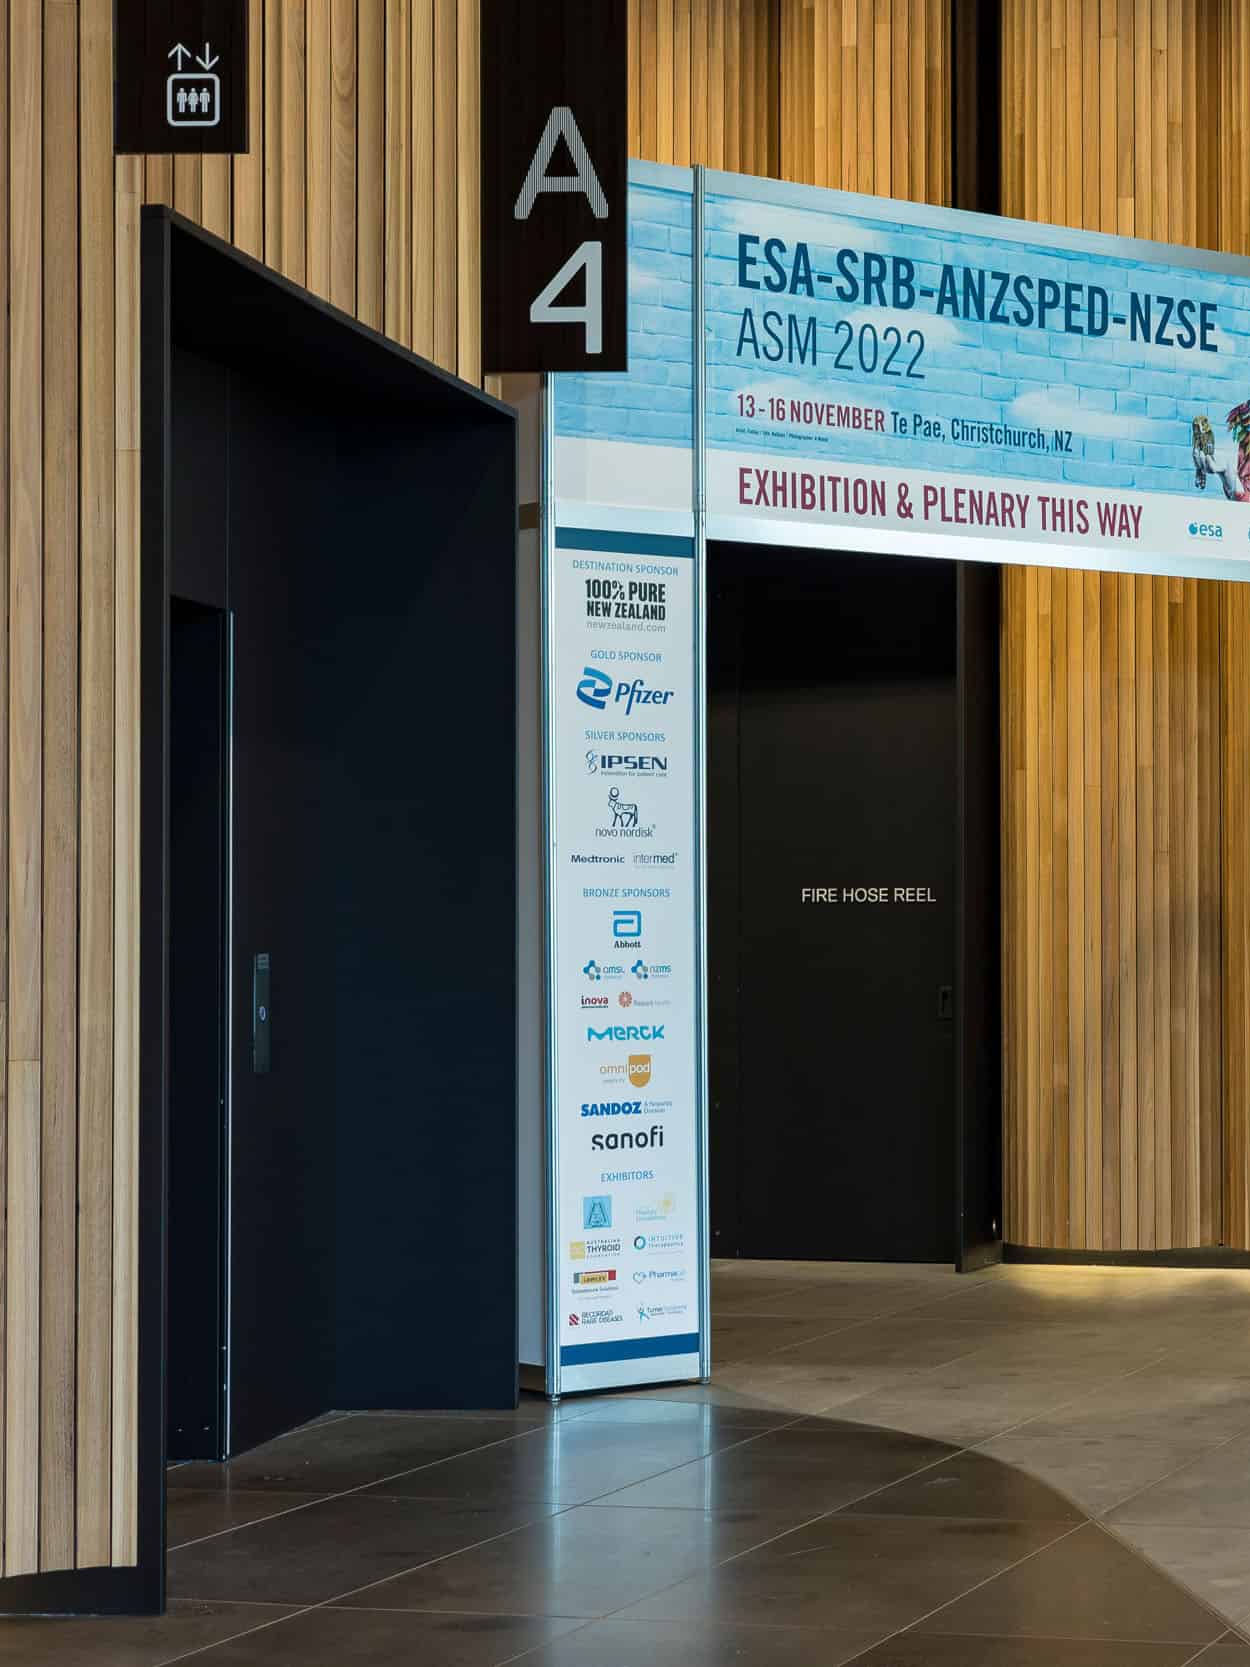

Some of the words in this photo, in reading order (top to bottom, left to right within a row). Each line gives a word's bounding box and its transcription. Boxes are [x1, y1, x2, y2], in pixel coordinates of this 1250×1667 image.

[514, 106, 609, 219] A
[530, 241, 602, 354] 4
[737, 233, 1219, 353] ESA-SRB-ANZSPED-NZSE
[735, 307, 818, 366] ASM
[833, 320, 926, 379] 2022
[790, 400, 886, 433] NOVEMBER
[891, 411, 908, 435] Te
[912, 414, 946, 442] Pae,
[950, 418, 1050, 453] Christchurch,
[1053, 430, 1073, 453] NZ
[739, 467, 886, 517] EXHIBITION
[896, 482, 914, 519] &
[922, 484, 1030, 529] PLENARY
[1037, 496, 1089, 534] THIS
[1096, 501, 1143, 538] WAY
[1199, 523, 1223, 537] esa
[572, 559, 633, 574] DESTINATION
[635, 564, 679, 577] SPONSOR
[585, 579, 625, 601] 100%
[629, 581, 666, 603] PURE
[586, 600, 612, 618] NEW
[614, 602, 666, 621] ZEALAND
[590, 649, 616, 662] GOLD
[618, 651, 662, 664] SPONSOR
[615, 678, 675, 716] Pfizer
[585, 730, 615, 742] SILVER
[617, 731, 666, 743] SPONSORS
[601, 755, 668, 770] IPSEN
[595, 828, 618, 838] novo
[620, 828, 654, 839] nordisk
[570, 853, 625, 865] Medtronic
[582, 888, 620, 899] BRONZE
[622, 888, 671, 899] SPONSORS
[801, 888, 839, 904] FIRE
[843, 887, 889, 904] HOSE
[893, 887, 937, 903] REEL
[613, 940, 642, 950] Abbott
[581, 995, 609, 1006] inova
[587, 1025, 665, 1041] MERCK
[580, 1101, 643, 1118] SANDOZ
[591, 1125, 664, 1151] sanofi
[600, 1169, 655, 1183] EXHIBITORS
[586, 1244, 621, 1253] THYROID
